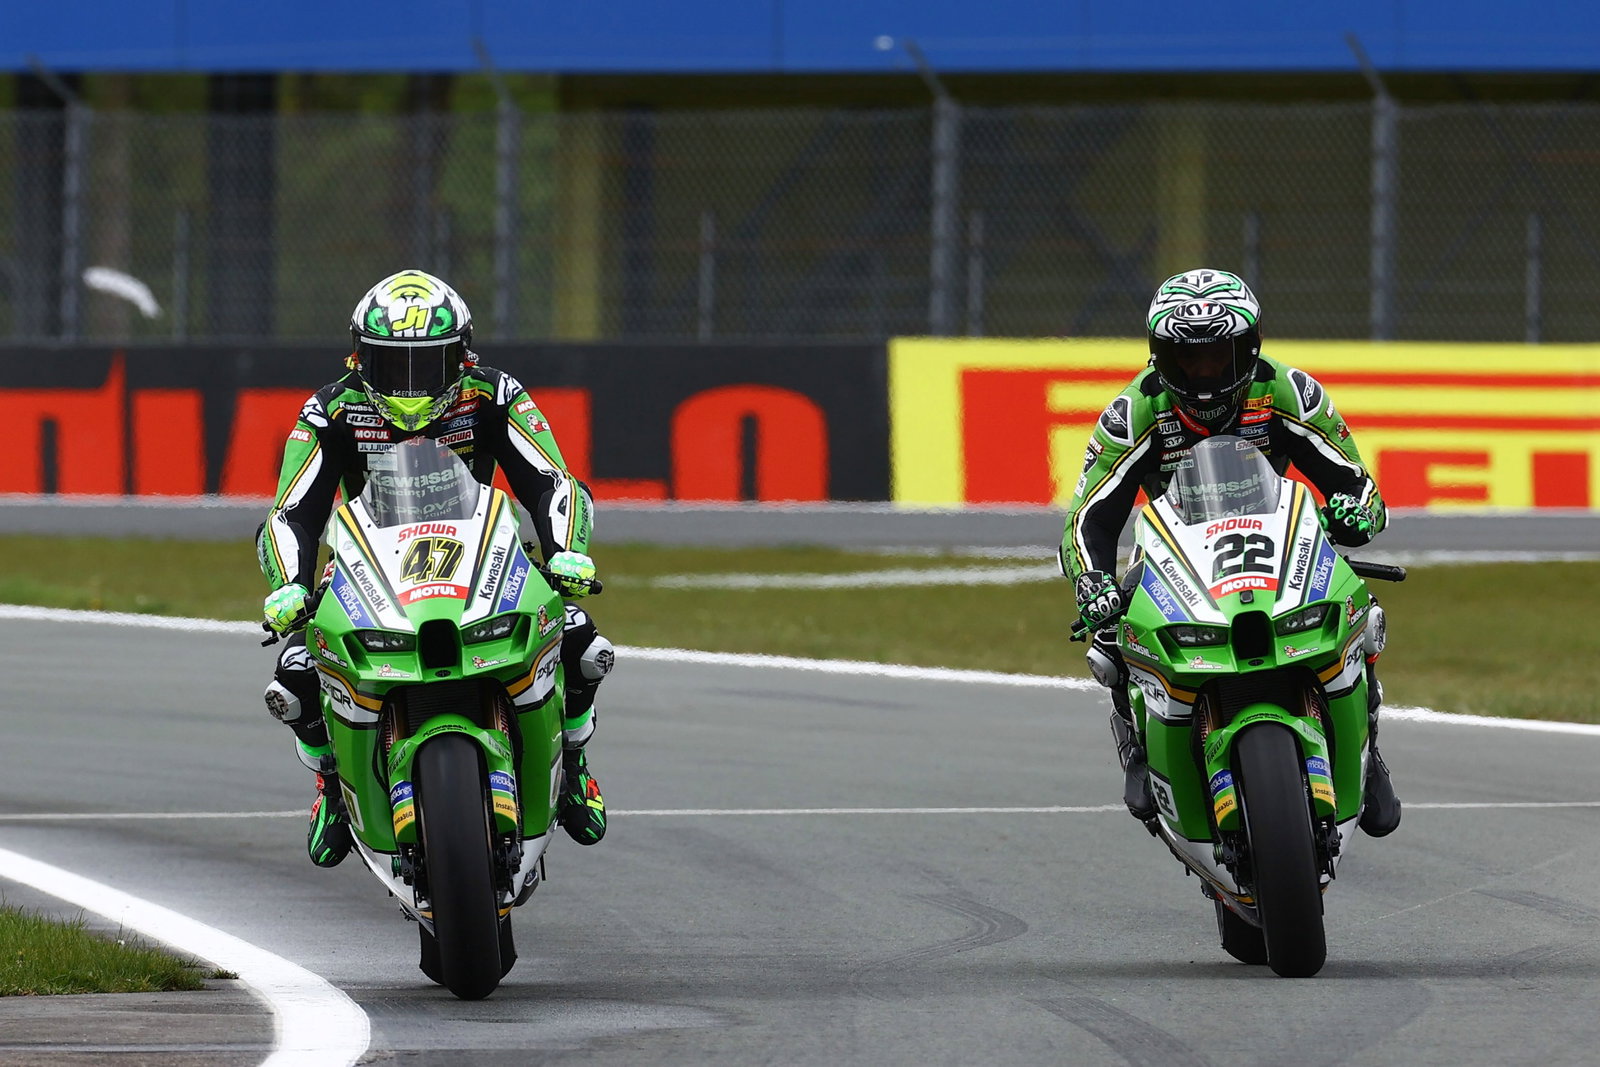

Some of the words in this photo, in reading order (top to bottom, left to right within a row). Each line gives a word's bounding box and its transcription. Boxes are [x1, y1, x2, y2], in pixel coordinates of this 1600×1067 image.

[339, 401, 374, 412] Kawasa
[354, 429, 389, 440] MOTUL
[437, 430, 472, 446] SHOWA
[1162, 449, 1192, 461] MOTUL
[398, 523, 457, 543] SHOWA
[1206, 518, 1263, 539] SHOWA
[400, 536, 464, 585] 47
[1212, 532, 1275, 583] 22
[1288, 536, 1312, 592] Kawasaki
[479, 545, 507, 601] Kawasaki
[1160, 557, 1202, 608] Kawasaki
[350, 559, 390, 613] Kawasaki
[409, 586, 458, 601] MOTUL
[1220, 577, 1268, 595] MOTUL
